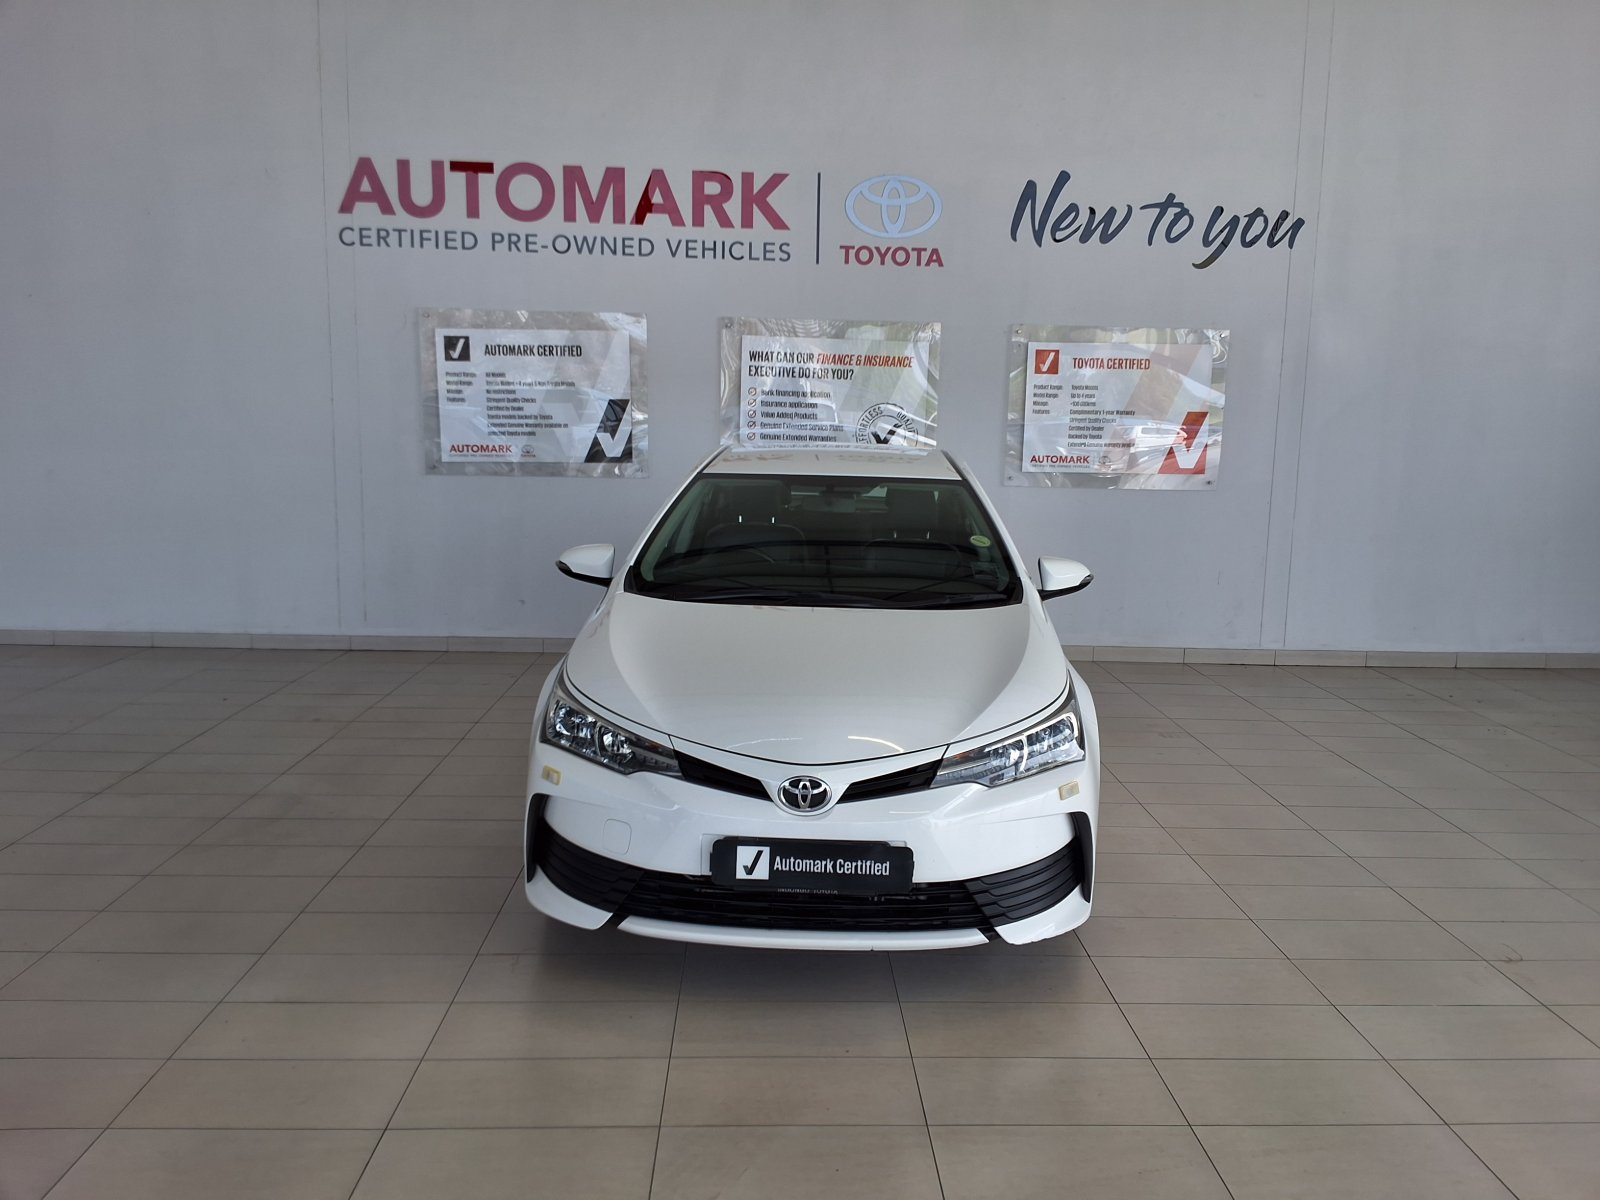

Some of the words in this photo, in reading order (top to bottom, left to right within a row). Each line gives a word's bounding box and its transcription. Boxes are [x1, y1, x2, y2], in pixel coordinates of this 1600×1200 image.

[337, 156, 792, 231] AUTOMARK
[1010, 170, 1133, 248] New
[1139, 193, 1194, 246] to
[1191, 206, 1305, 270] you
[338, 226, 479, 251] CERTIFIED
[491, 232, 656, 258] PRE-OWNED
[666, 238, 792, 262] VEHICLES
[839, 244, 945, 268] TOYOTA
[484, 344, 535, 357] AUTOMARK
[536, 345, 582, 357] CERTIFIED
[748, 350, 774, 363] WHAT
[776, 351, 795, 364] CAN
[796, 352, 815, 364] OUR
[816, 353, 854, 366] FINANCE
[855, 354, 862, 366] &
[863, 354, 914, 368] INSURANCE
[1072, 357, 1105, 369] TOYOTA
[1106, 358, 1151, 370] CERTIFIED
[748, 365, 799, 378] EXECUTIVE
[799, 366, 811, 379] DO
[812, 367, 829, 380] FOR
[831, 368, 854, 380] YOU?
[760, 400, 787, 408] Insurance
[760, 410, 775, 419] Value
[776, 411, 793, 420] Added
[793, 412, 818, 420] Products
[760, 432, 781, 440] Genuine
[782, 433, 808, 441] Extended
[449, 444, 513, 453] AUTOMARK
[1029, 455, 1090, 464] AUTOMARK
[773, 856, 834, 873] Automark
[836, 858, 890, 876] Certified
